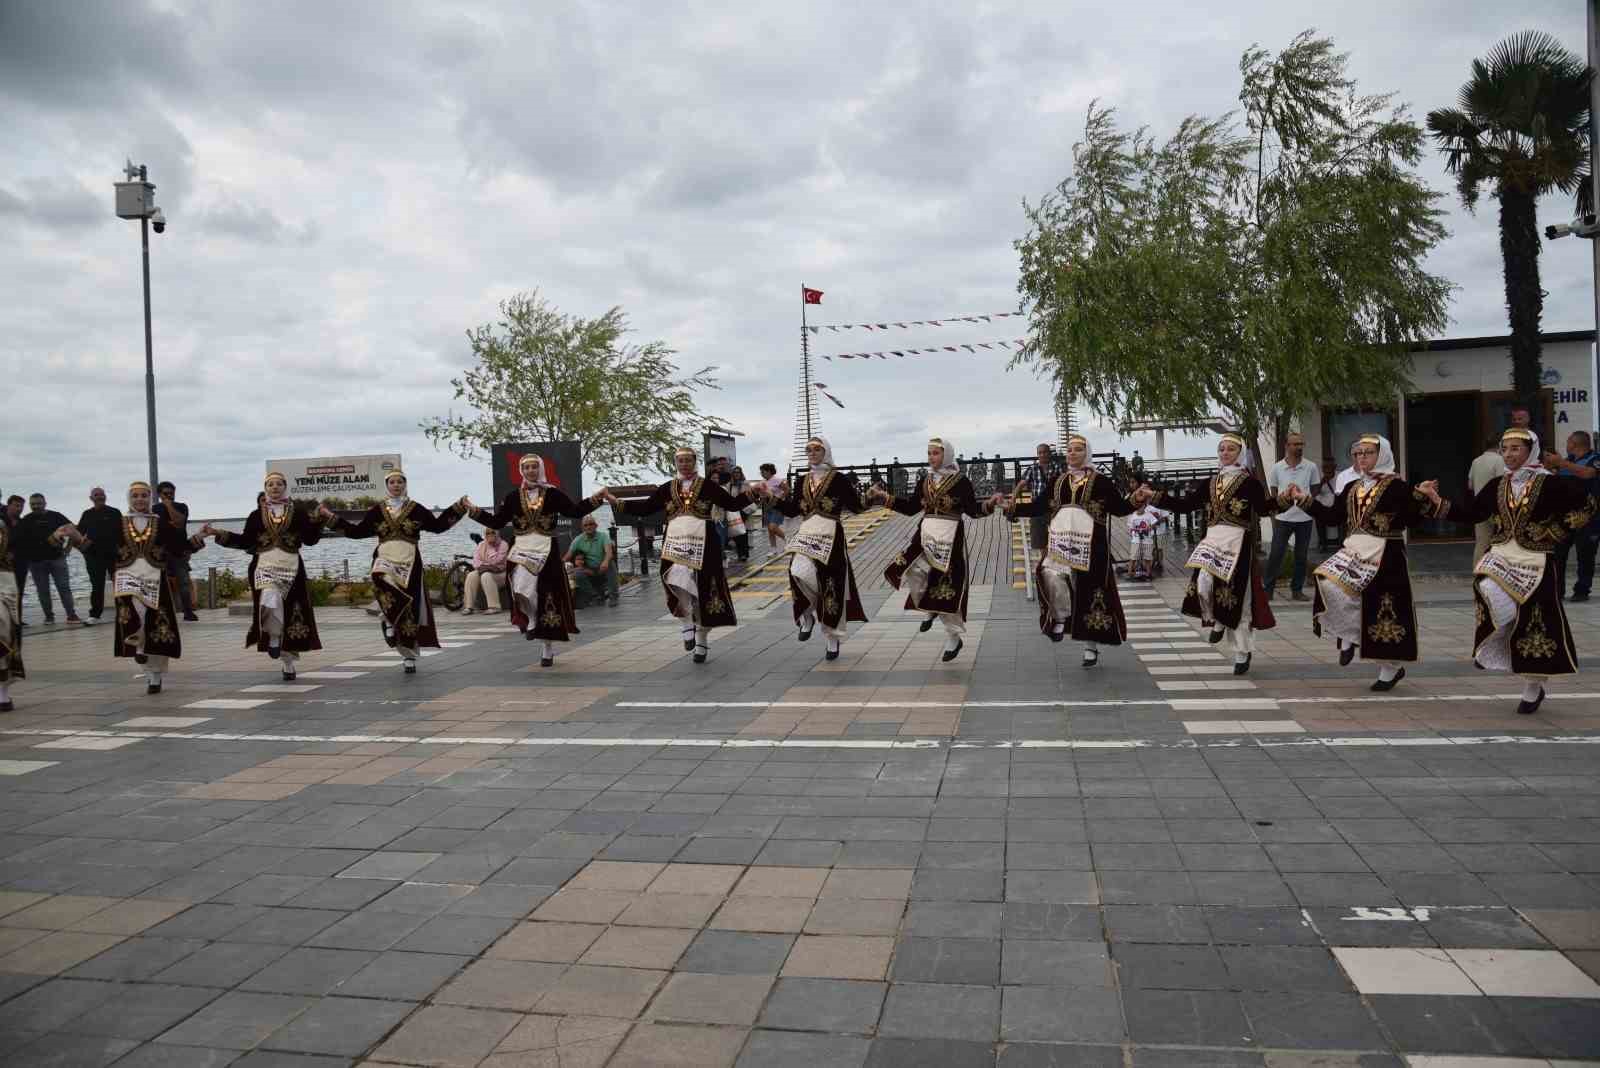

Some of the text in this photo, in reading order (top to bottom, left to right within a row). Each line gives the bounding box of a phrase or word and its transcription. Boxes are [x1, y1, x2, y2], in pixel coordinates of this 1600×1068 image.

[295, 474, 370, 487] YENİ MÜZE ALANI
